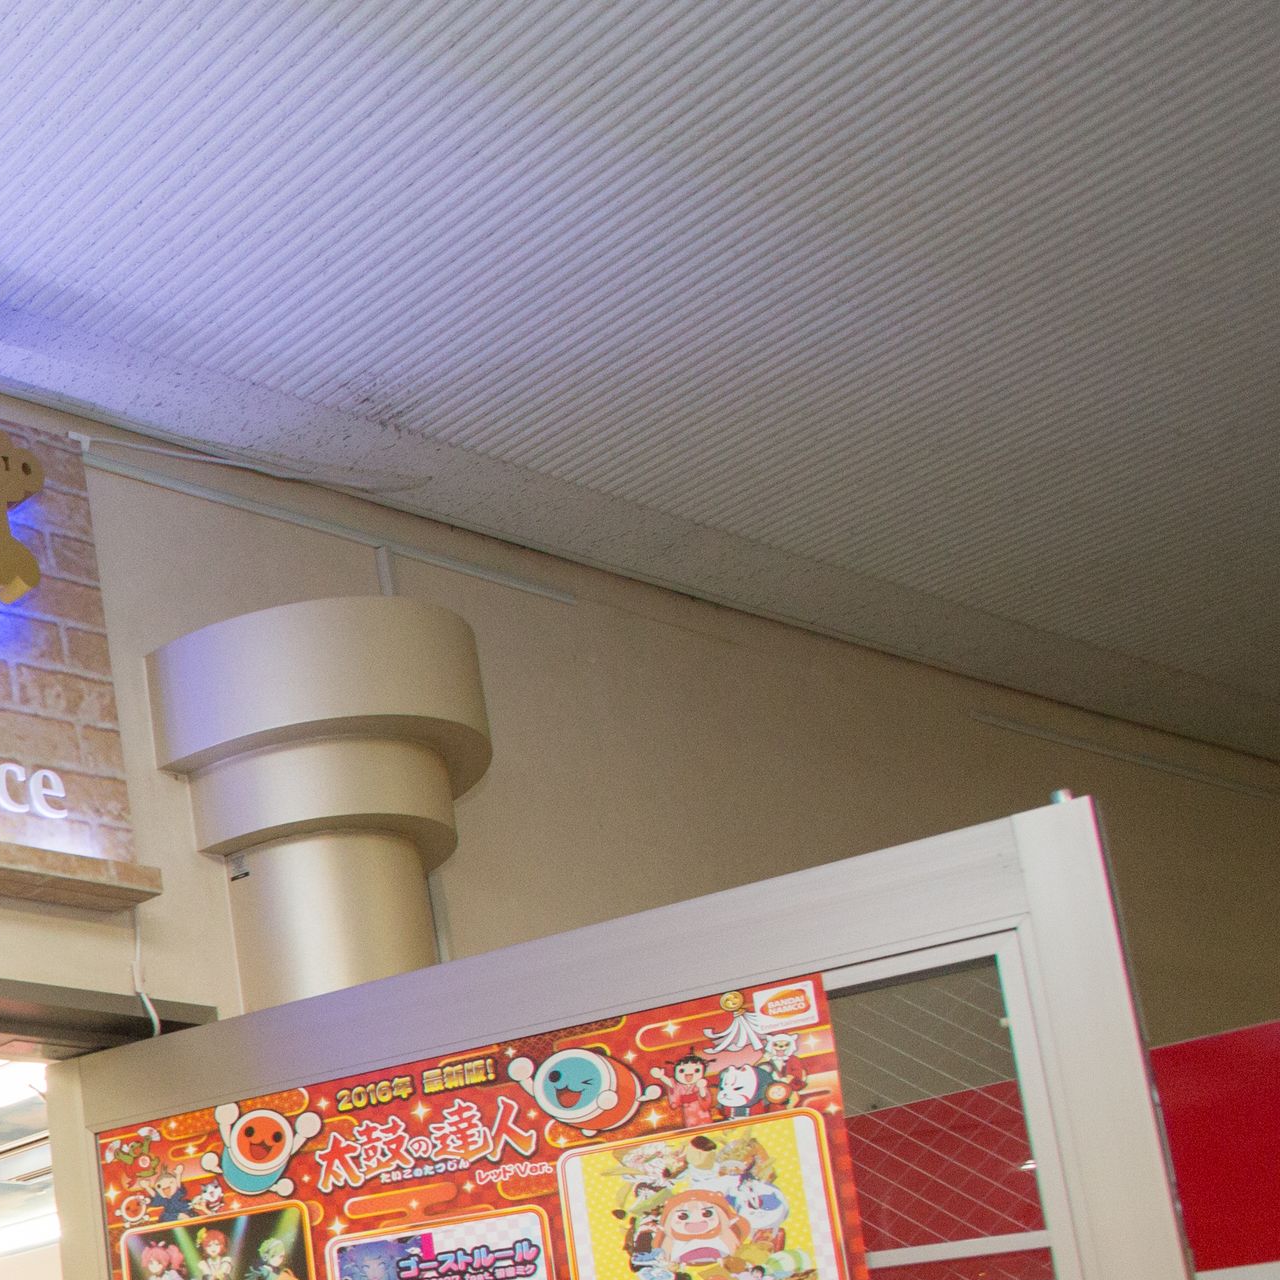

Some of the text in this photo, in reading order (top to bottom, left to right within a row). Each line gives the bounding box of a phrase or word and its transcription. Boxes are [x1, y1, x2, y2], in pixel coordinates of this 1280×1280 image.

[767, 995, 805, 1009] BANDAI
[767, 1003, 806, 1016] NAMCO
[336, 1075, 414, 1112] 2016年
[315, 1096, 537, 1194] 太鼓の達人
[397, 1238, 540, 1280] ゴーストルール
